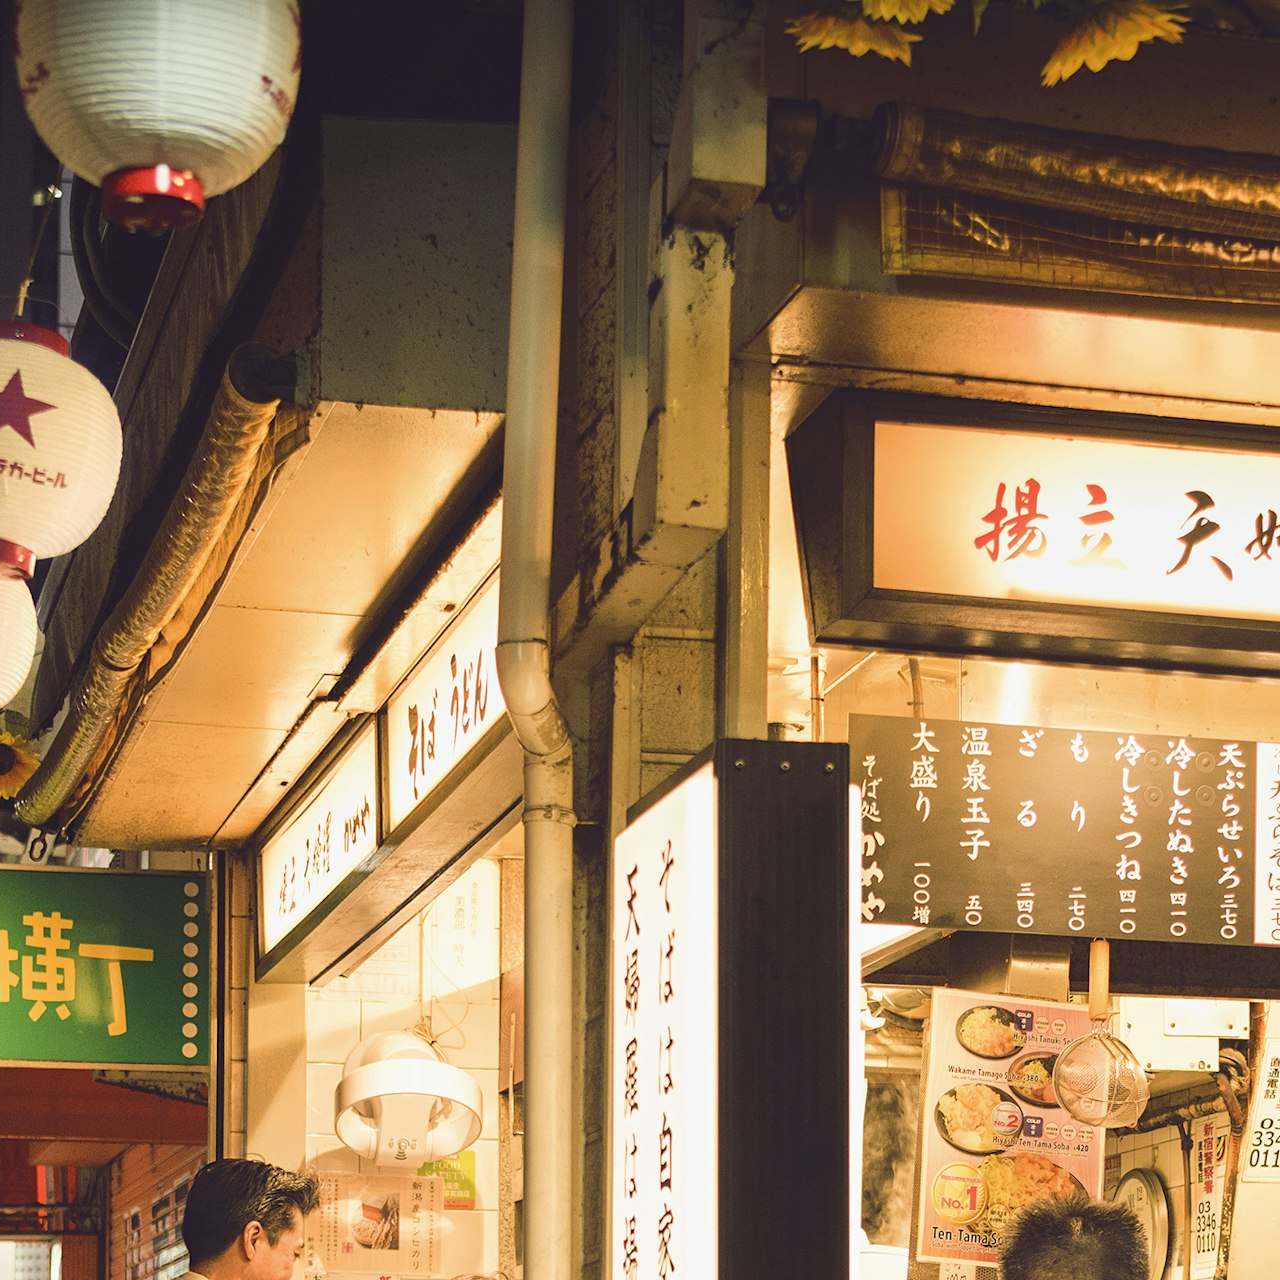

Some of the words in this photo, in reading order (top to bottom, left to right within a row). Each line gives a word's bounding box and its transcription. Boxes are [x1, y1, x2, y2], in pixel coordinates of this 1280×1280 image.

[974, 477, 1128, 571] 揚立
[408, 688, 439, 801] そば
[450, 648, 489, 752] うどん
[910, 722, 940, 822] 大盛り
[959, 727, 992, 861] 温泉玉子
[1017, 729, 1044, 828] ざる
[1070, 732, 1089, 832] もり
[1114, 735, 1146, 881] 冷しきつね
[1165, 738, 1196, 885] 冷したぬき
[1216, 743, 1246, 889] 天ぷらせいろ
[912, 862, 931, 924] 一〇〇増
[965, 895, 983, 925] 五〇
[1016, 882, 1035, 928] 三四〇
[1068, 886, 1086, 931] 二七〇
[1119, 889, 1137, 934] 四一〇
[1169, 892, 1187, 937] 四一〇
[1220, 893, 1238, 939] 三七〇
[948, 1065, 976, 1075] Wakame
[978, 1069, 1003, 1080] Tamago
[1004, 1072, 1020, 1082] Soba
[1053, 1141, 1070, 1151] Soba
[1203, 1121, 1214, 1194] 新宿警察署
[940, 1185, 978, 1211] No.1
[1198, 1201, 1211, 1214] 03
[411, 1181, 423, 1270] 新潟産コシヒカリ
[932, 1226, 988, 1245] Ten-Tama
[1196, 1213, 1216, 1233] 3346
[1196, 1232, 1216, 1253] 0110
